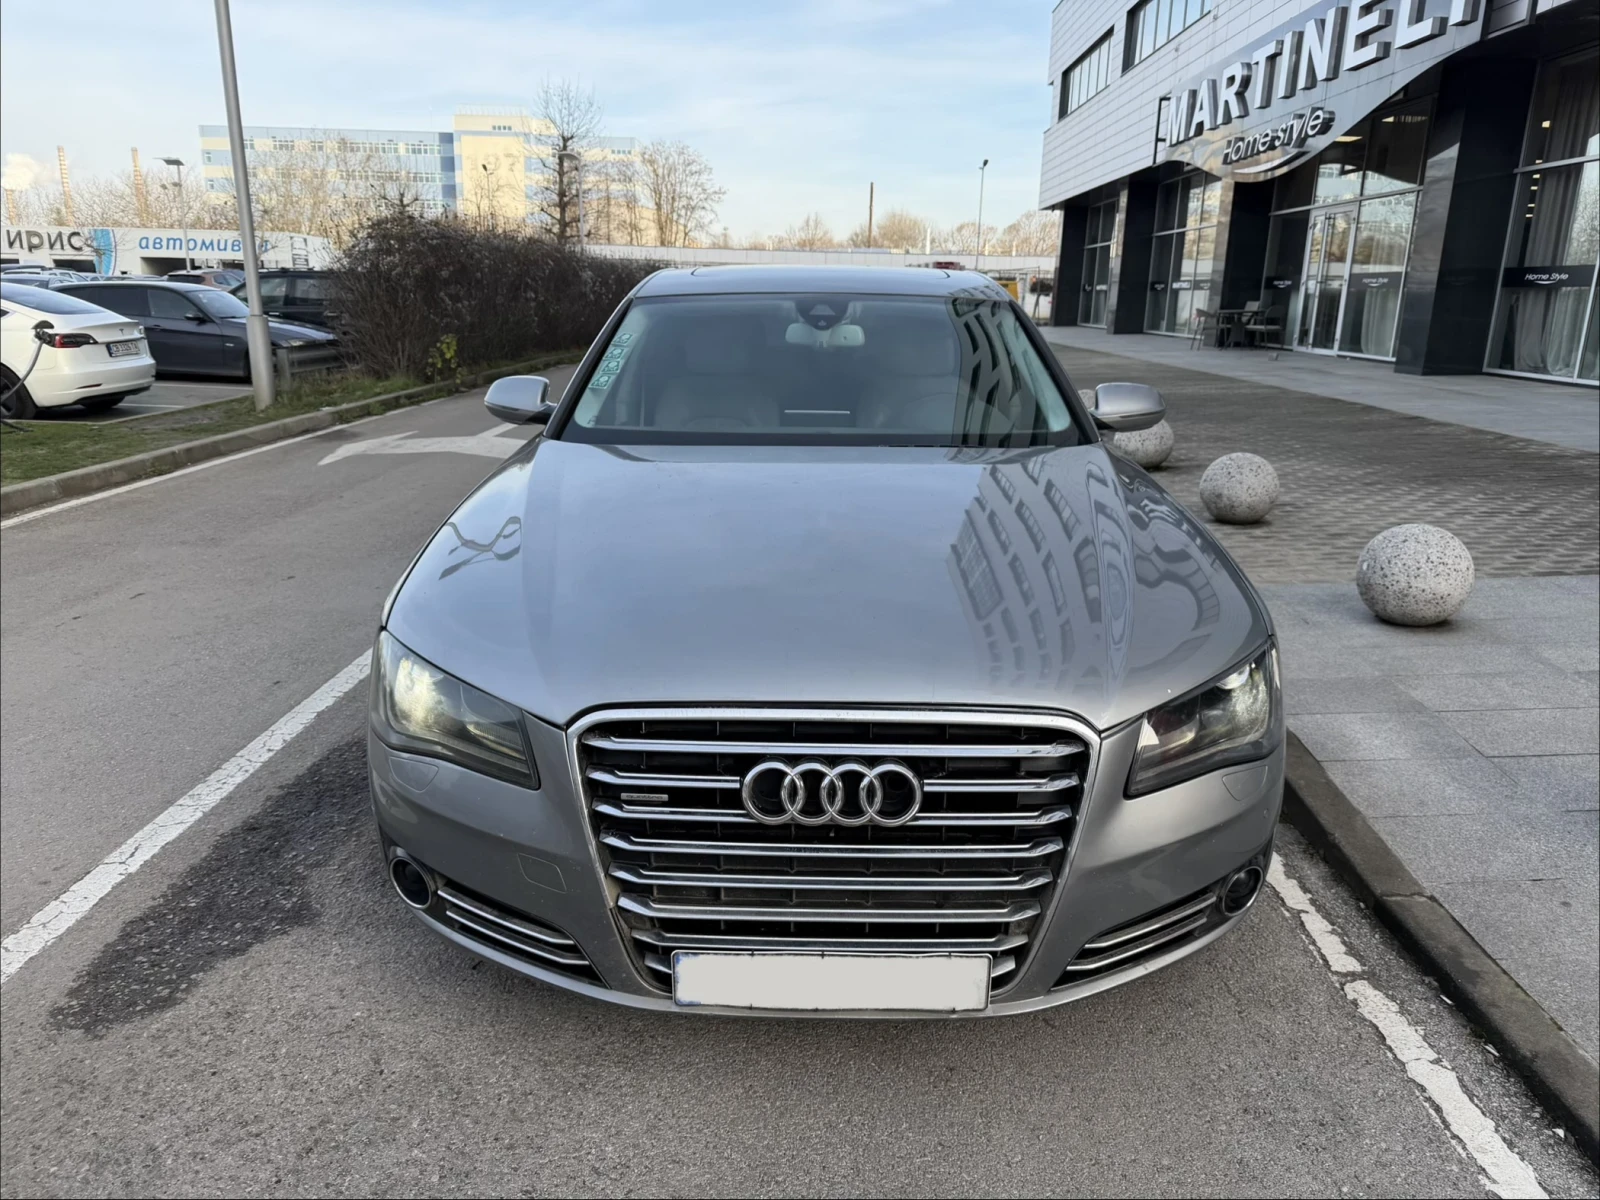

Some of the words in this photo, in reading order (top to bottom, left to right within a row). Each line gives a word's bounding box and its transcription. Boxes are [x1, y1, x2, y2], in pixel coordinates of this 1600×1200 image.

[1223, 129, 1274, 163] Home
[1275, 107, 1328, 148] style
[138, 236, 269, 252] автомива
[1524, 273, 1549, 281] Home
[1550, 272, 1569, 281] Style
